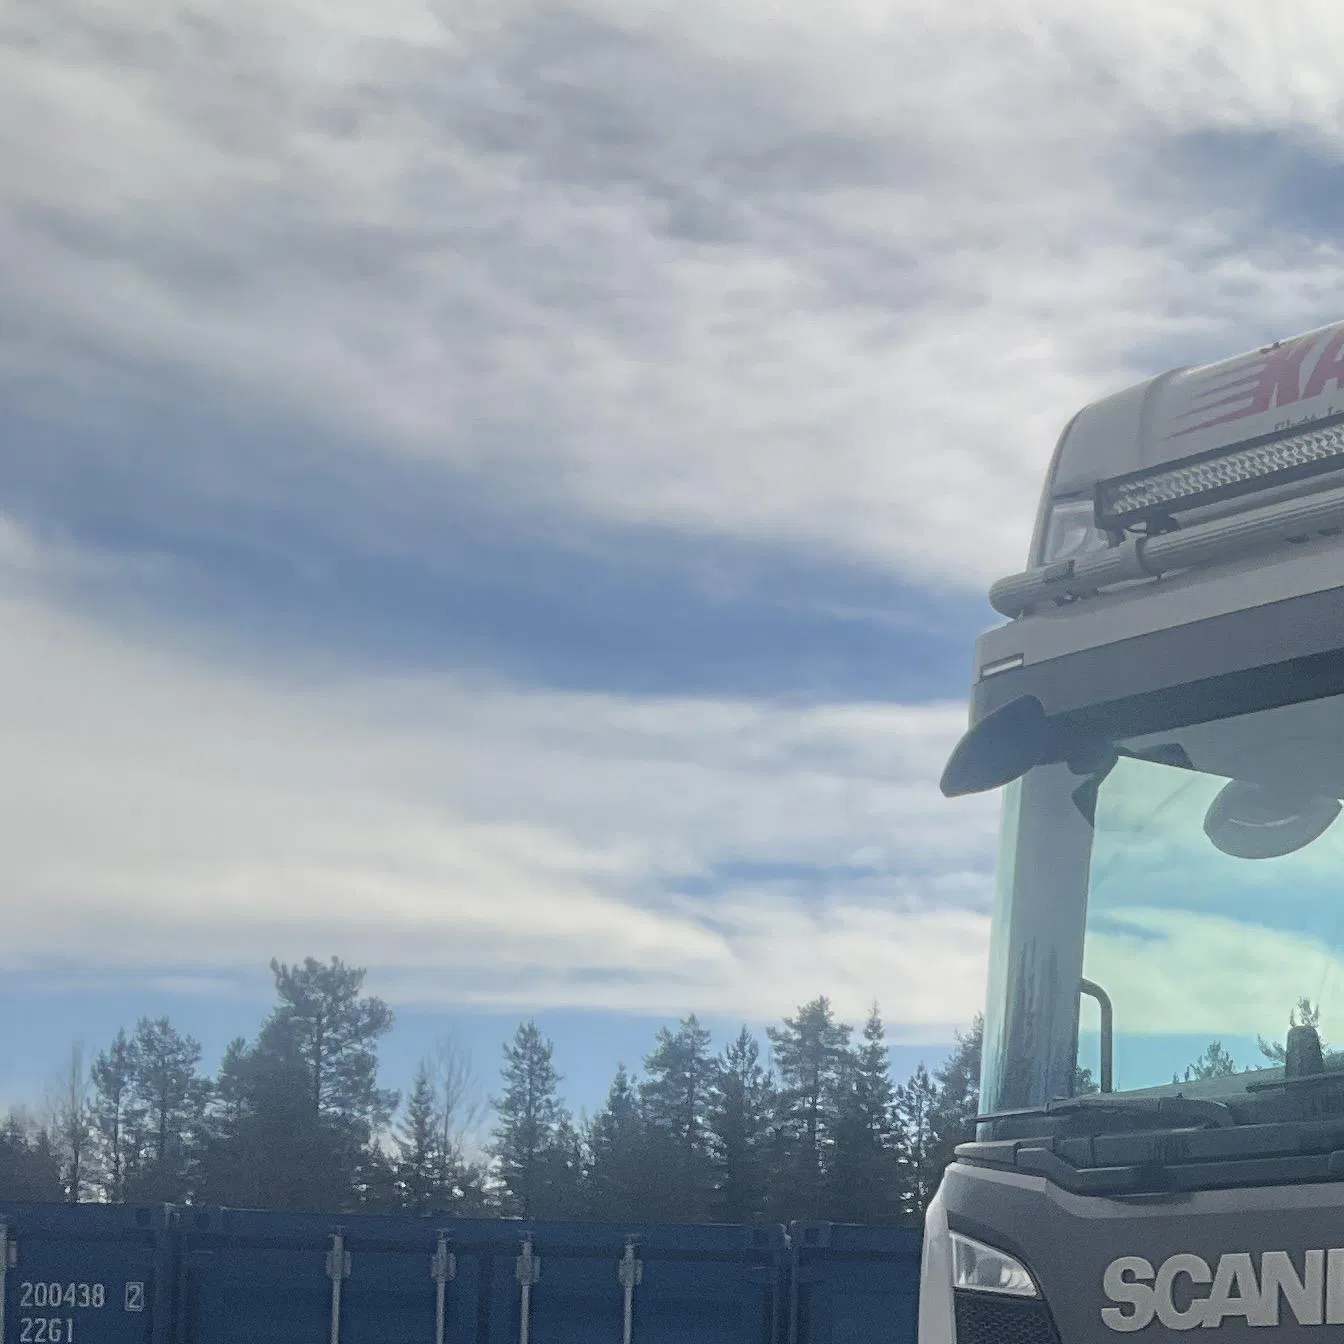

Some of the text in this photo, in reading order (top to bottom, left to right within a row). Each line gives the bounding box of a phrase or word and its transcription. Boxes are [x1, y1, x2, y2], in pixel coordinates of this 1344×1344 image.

[20, 1282, 142, 1310] 200438 2
[20, 1318, 73, 1343] 22G1
